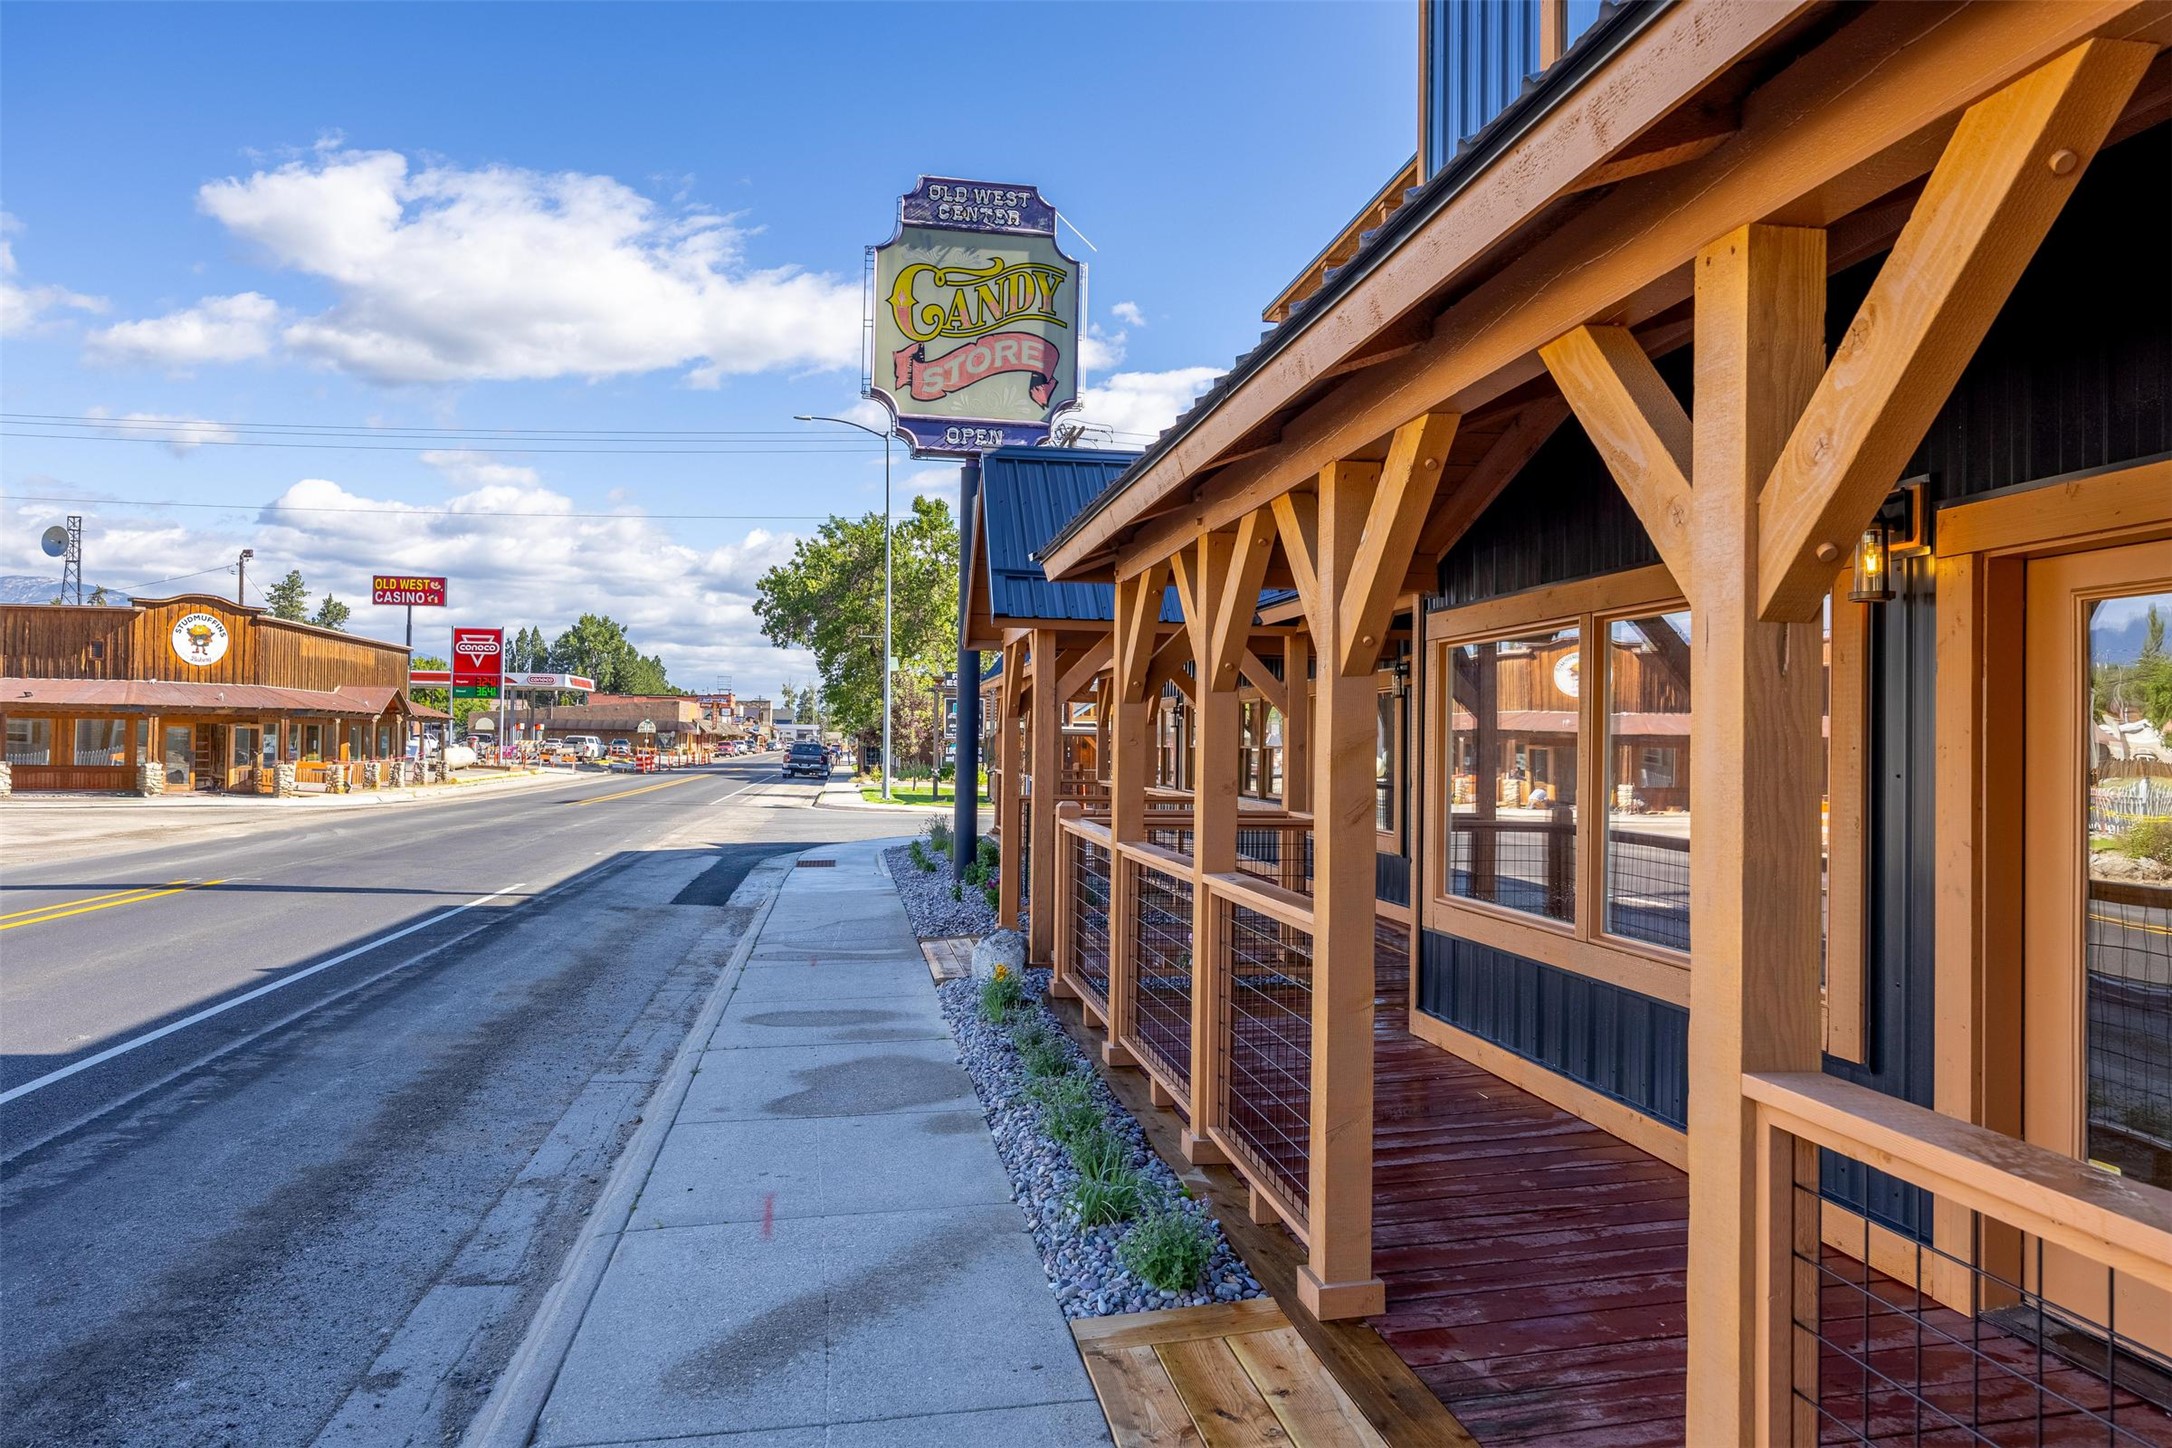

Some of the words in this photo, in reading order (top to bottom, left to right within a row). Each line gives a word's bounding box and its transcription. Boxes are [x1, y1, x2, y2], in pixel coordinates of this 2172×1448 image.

[928, 184, 968, 202] OLD
[973, 188, 1031, 208] WEST
[937, 203, 1021, 227] CENTER
[886, 257, 1067, 342] CANDY
[921, 339, 1046, 394] STORE
[945, 426, 1004, 446] OPEN
[374, 578, 397, 590] OLD
[400, 579, 430, 591] WEST
[374, 590, 425, 604] CASINO
[175, 614, 227, 638] STUDMUFFINS
